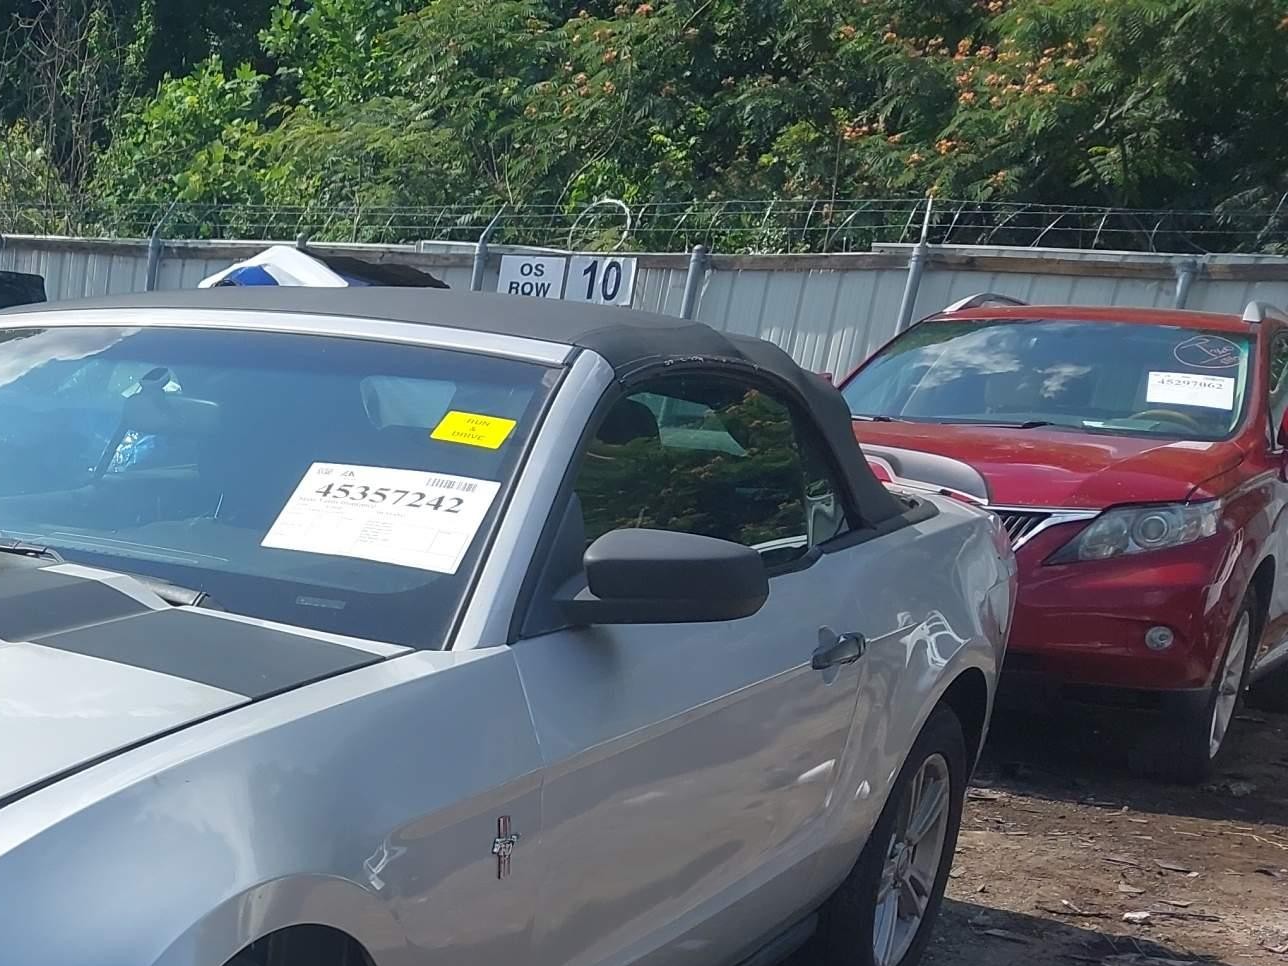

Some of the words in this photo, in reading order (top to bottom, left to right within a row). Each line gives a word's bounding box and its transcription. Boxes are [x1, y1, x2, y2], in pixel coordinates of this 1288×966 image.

[519, 263, 545, 277] OS
[583, 260, 622, 301] 10
[508, 281, 551, 298] ROW
[466, 418, 491, 427] RUN
[315, 482, 465, 514] 45357242
